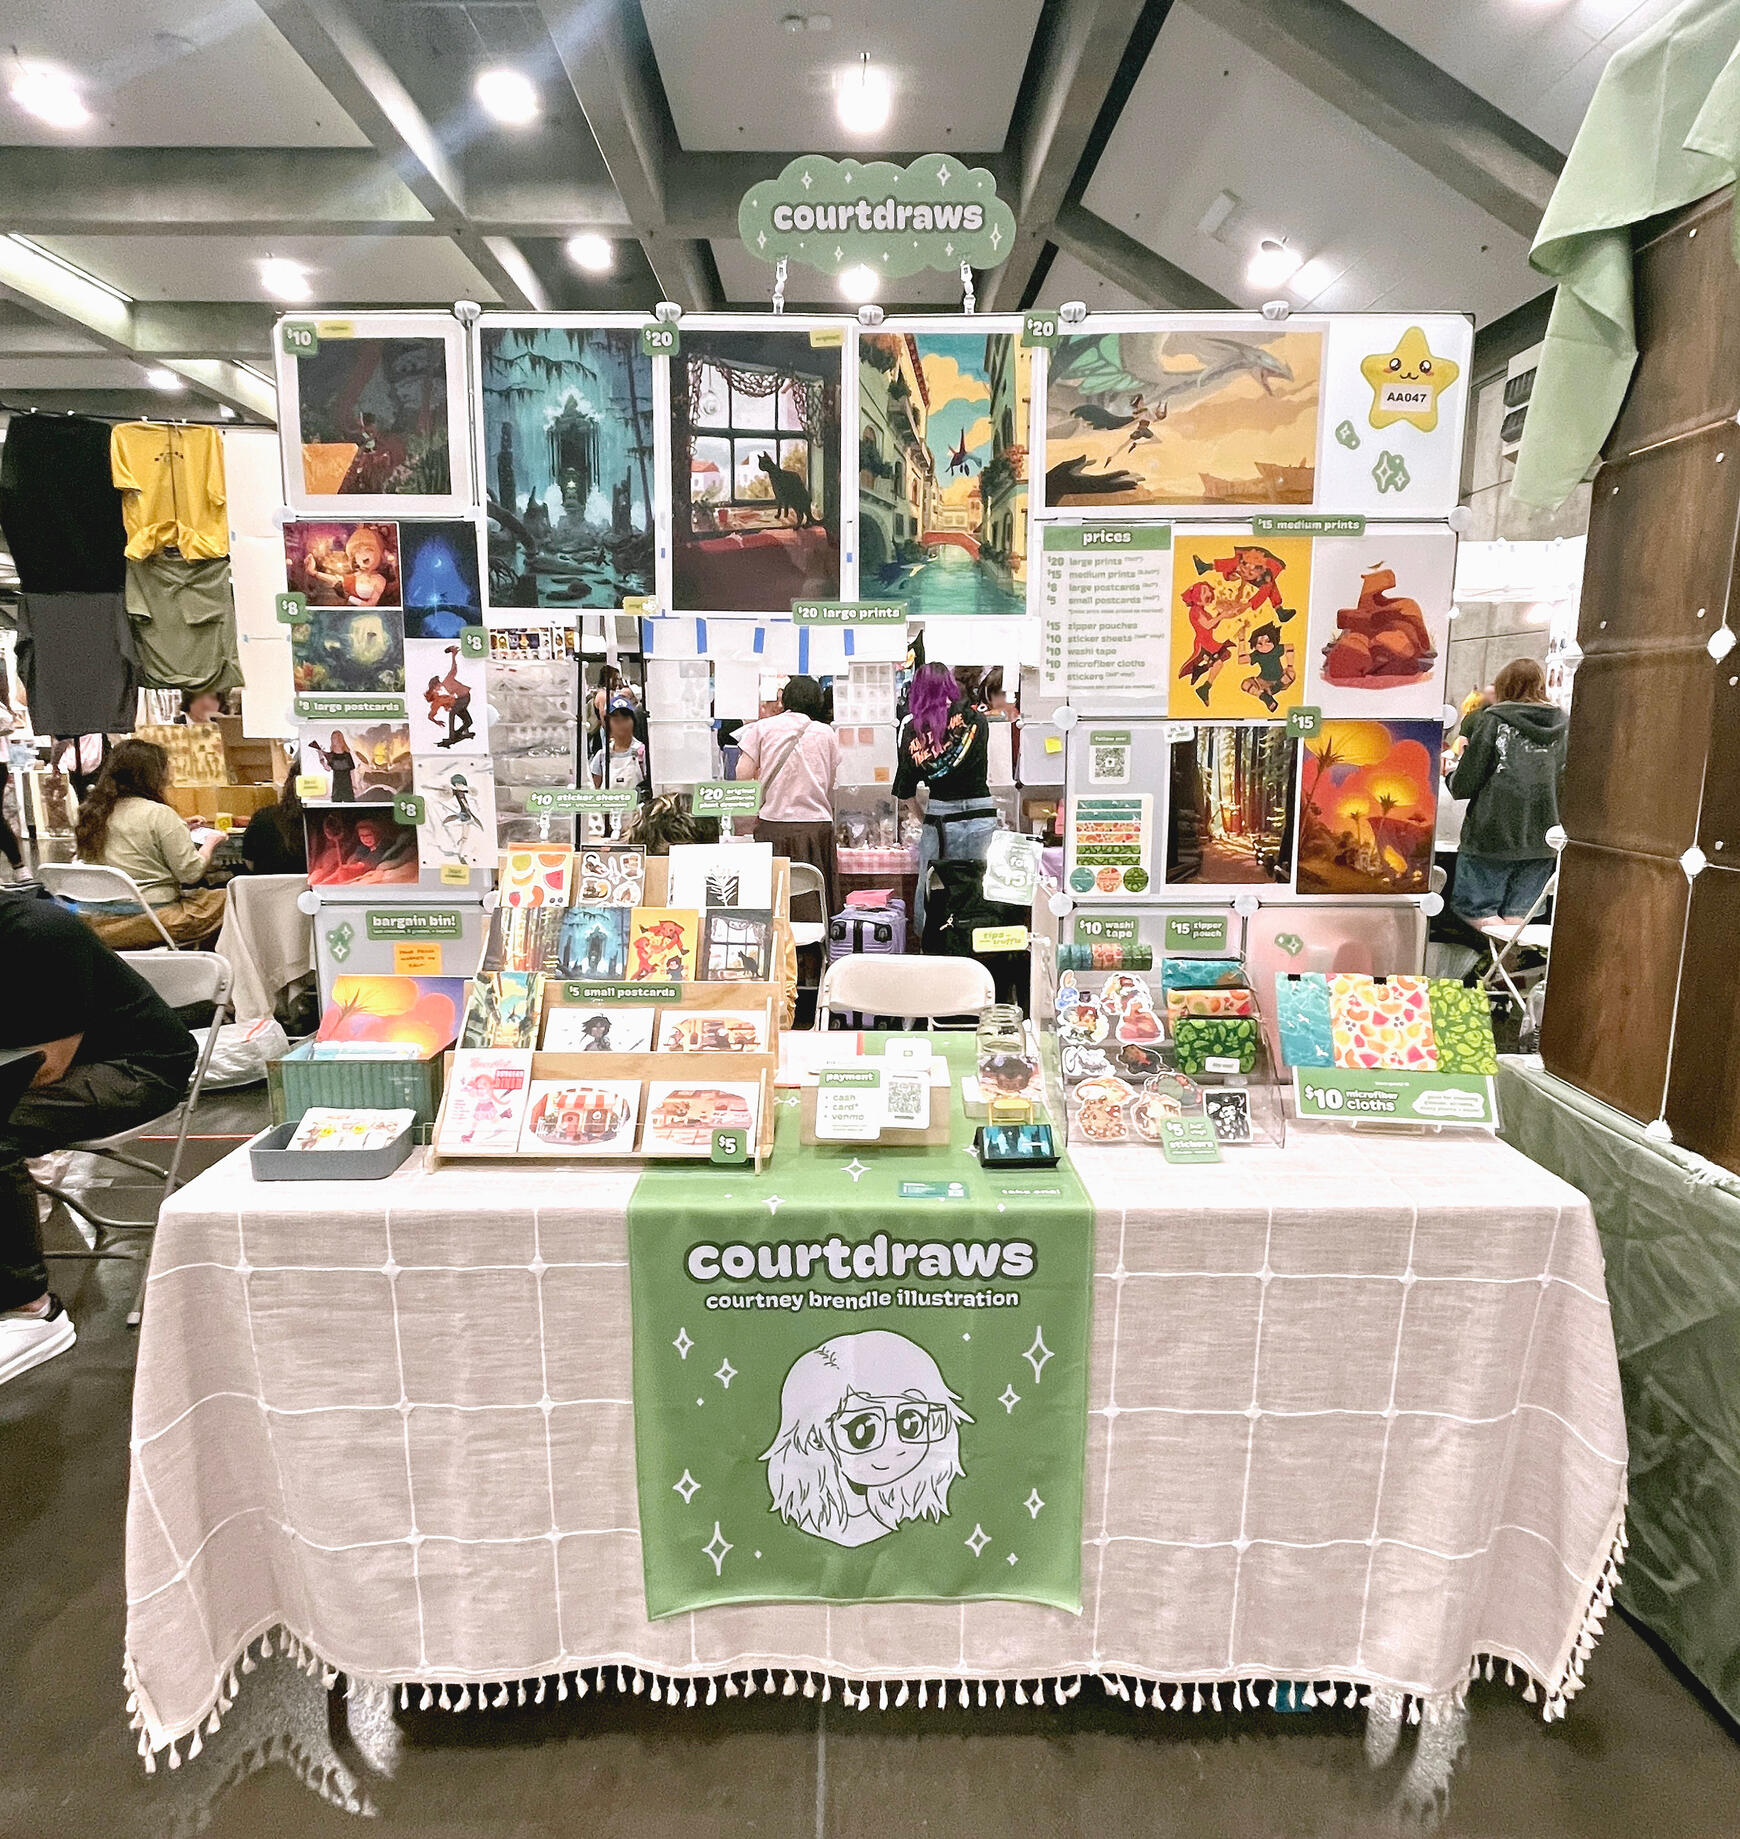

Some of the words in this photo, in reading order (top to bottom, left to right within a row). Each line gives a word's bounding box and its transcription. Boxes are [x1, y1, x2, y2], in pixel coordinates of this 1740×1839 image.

[773, 198, 984, 231] courtdraws
[1027, 318, 1054, 337] $20
[287, 327, 312, 346] $10
[645, 330, 673, 347] $20
[1387, 392, 1427, 403] AA047
[1277, 520, 1322, 529] medium
[1324, 520, 1360, 531] prints
[1082, 529, 1132, 546] prices
[1048, 556, 1064, 567] $20
[1069, 558, 1092, 567] large
[1094, 557, 1122, 567] prints
[1047, 569, 1062, 579] $15
[1069, 570, 1105, 579] medium
[1107, 570, 1136, 580] prints
[1069, 583, 1091, 593] large
[1094, 583, 1140, 593] postcards
[282, 599, 298, 616] $8
[1068, 596, 1092, 605] small
[1094, 596, 1141, 606] postcards
[798, 606, 818, 618] $20
[823, 607, 857, 620] large
[859, 607, 900, 620] prints
[1047, 621, 1061, 631] $15
[1067, 622, 1097, 632] zipper
[1099, 622, 1138, 632] pouches
[467, 634, 482, 651] $8
[1046, 634, 1062, 644] $10
[1067, 634, 1099, 643] sticker
[1101, 634, 1132, 643] sheets
[1046, 647, 1061, 656] $10
[1067, 647, 1094, 656] washi
[1096, 648, 1117, 656] tape
[1046, 659, 1061, 669] $10
[1067, 659, 1115, 669] microfiber
[1117, 659, 1145, 668] cloths
[1067, 672, 1104, 681] stickers
[299, 700, 310, 710] $8
[314, 702, 342, 713] large
[344, 702, 399, 712] postcards
[1292, 714, 1314, 729] $15
[532, 793, 553, 806] $10
[556, 793, 594, 801] sticker
[699, 787, 724, 801] $20
[400, 801, 417, 817] $8
[372, 914, 426, 929] bargain
[429, 914, 456, 927] bin!
[1080, 920, 1102, 934] $10
[1105, 921, 1134, 929] washi
[1171, 920, 1190, 934] $15
[1193, 921, 1222, 930] zipper
[1106, 930, 1133, 939] tape
[1192, 930, 1222, 939] pouch
[569, 986, 580, 996] $5
[584, 987, 615, 997] small
[617, 987, 676, 999] postcards
[825, 1072, 875, 1083] payment
[1305, 1084, 1344, 1110] $10
[1346, 1099, 1396, 1112] cloths
[1166, 1121, 1184, 1137] $5
[718, 1135, 737, 1154] $5
[687, 1234, 1034, 1280] courtdraws
[705, 1290, 804, 1311] courtney
[808, 1290, 892, 1310] brendle
[896, 1289, 1019, 1307] illustration
